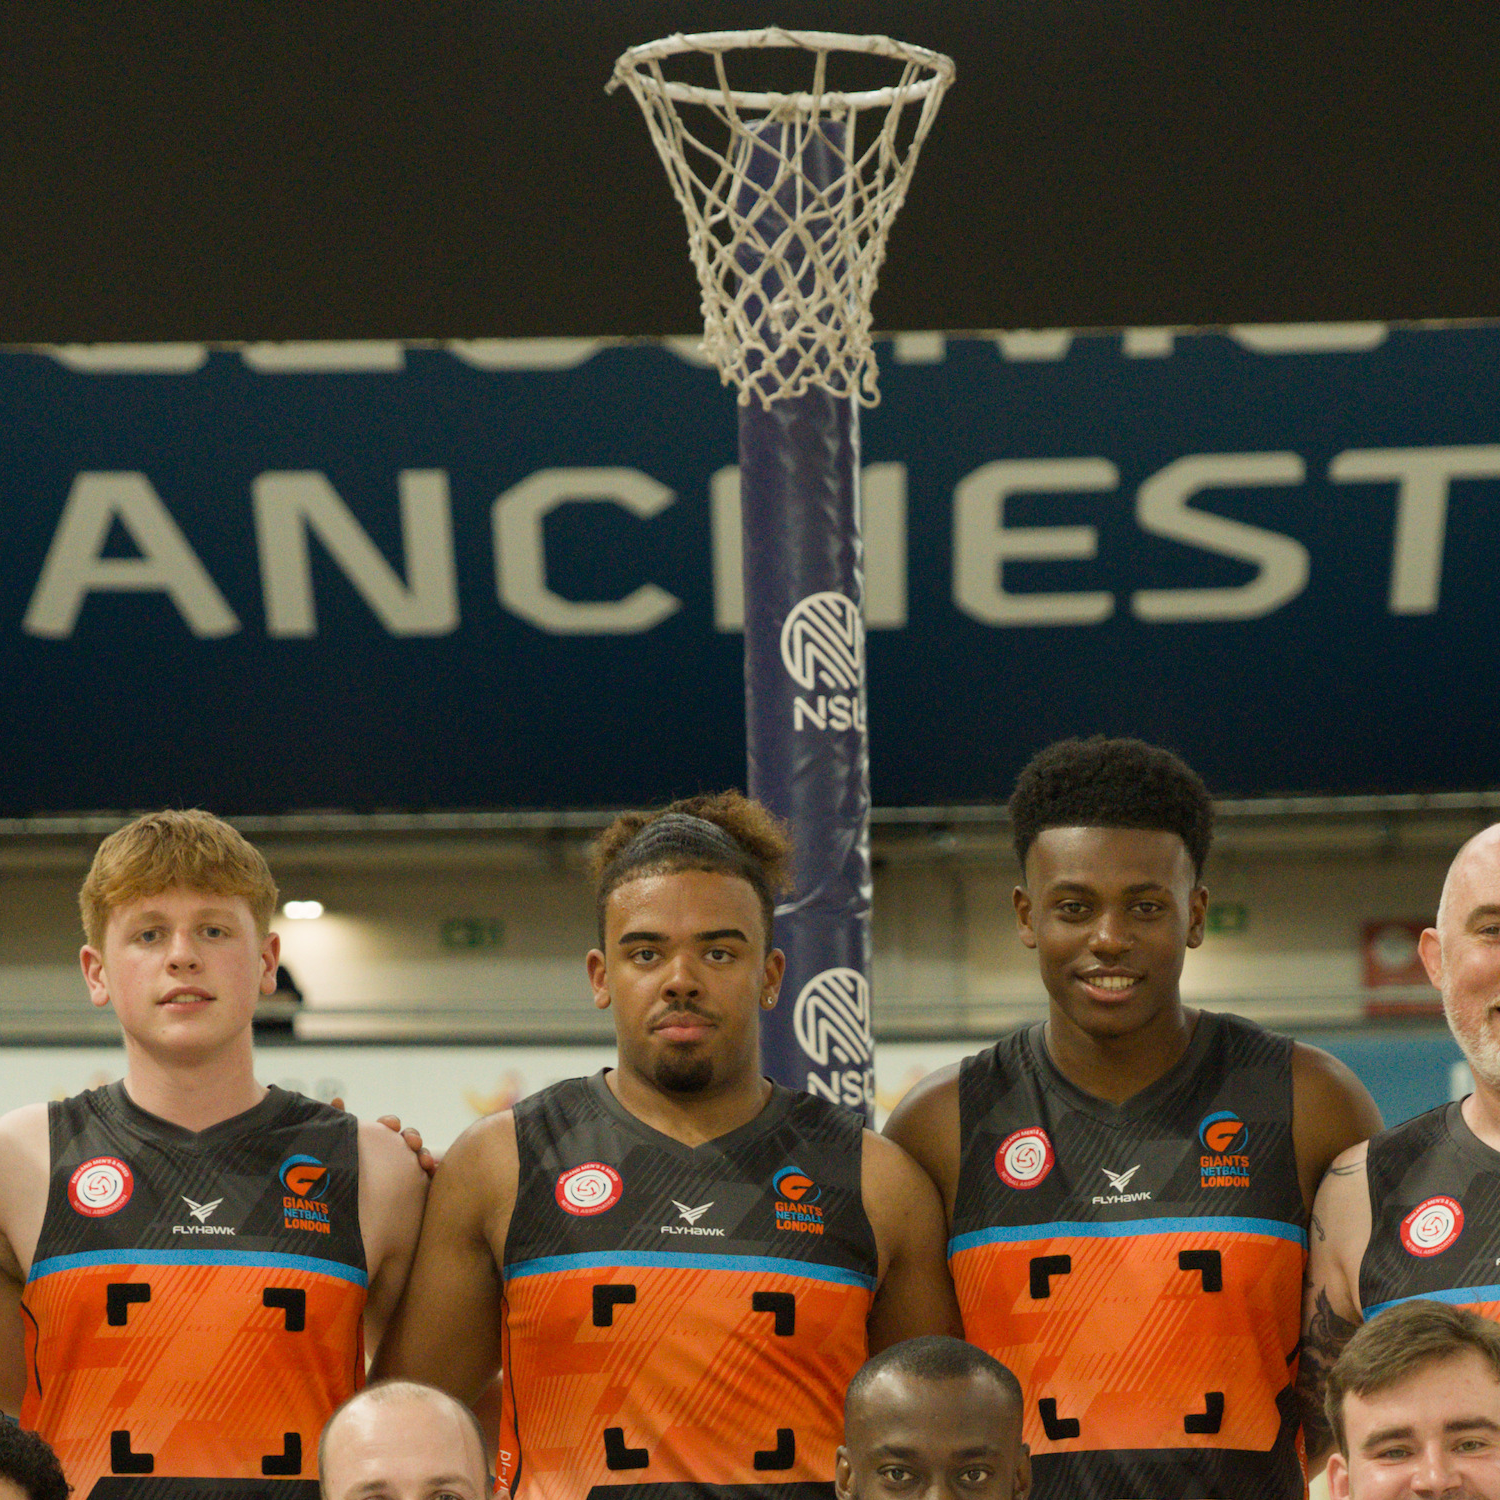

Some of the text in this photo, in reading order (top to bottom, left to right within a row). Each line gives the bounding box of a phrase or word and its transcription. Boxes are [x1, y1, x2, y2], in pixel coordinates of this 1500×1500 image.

[1200, 1155, 1249, 1168] GIANTS
[1200, 1167, 1249, 1177] NETBALL
[1201, 1176, 1249, 1188] LONDON
[283, 1197, 328, 1214] GIANTS
[775, 1201, 822, 1217] GIANTS
[284, 1208, 329, 1223] NETBALL
[776, 1211, 823, 1223] NETBALL
[284, 1218, 330, 1234] LONDON
[776, 1220, 823, 1235] LONDON
